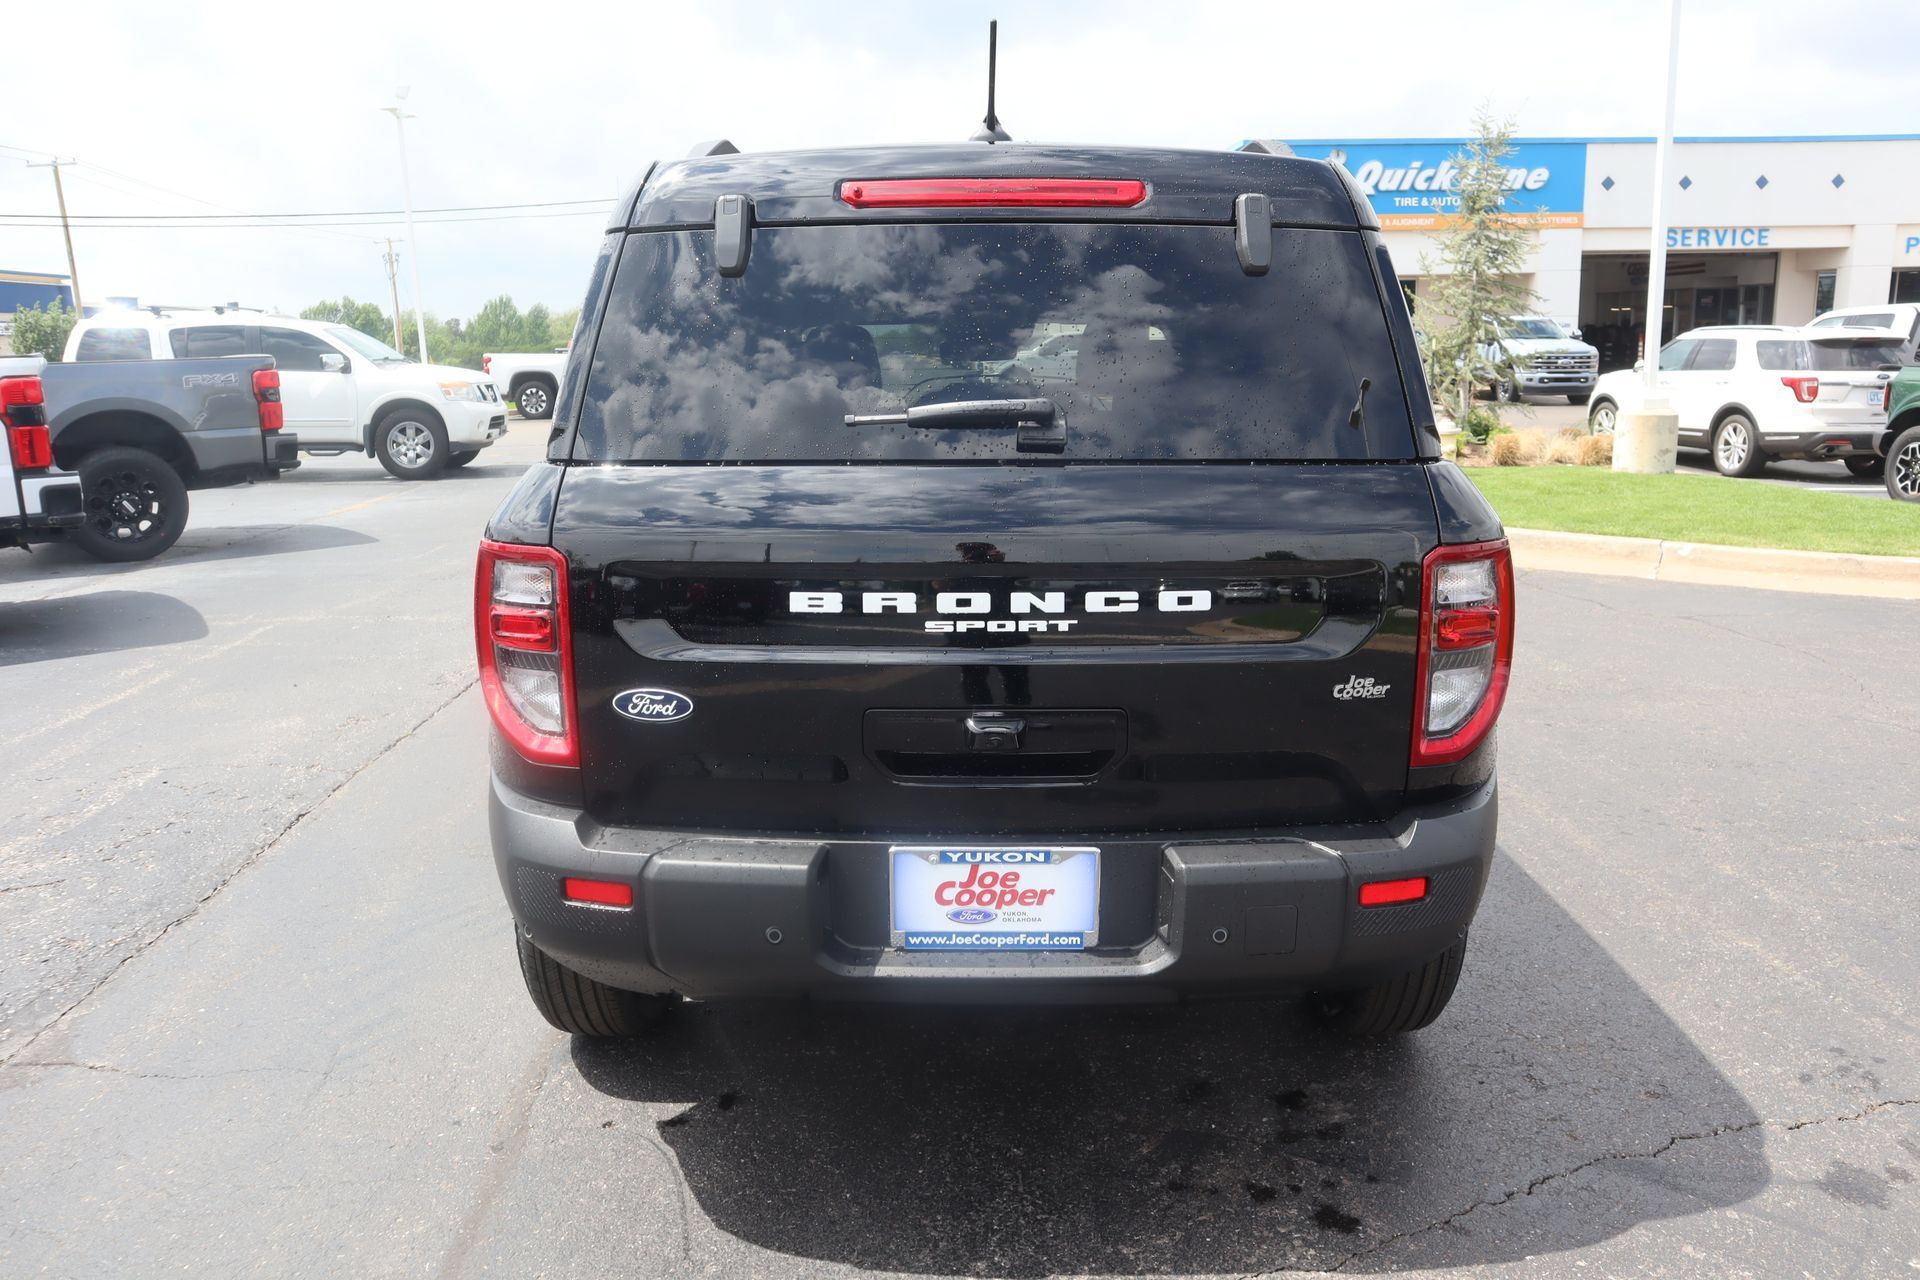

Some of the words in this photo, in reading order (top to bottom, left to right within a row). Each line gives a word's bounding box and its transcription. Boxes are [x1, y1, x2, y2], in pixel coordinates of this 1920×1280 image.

[1355, 160, 1454, 195] Quick
[1463, 163, 1550, 191] Lne
[1394, 197, 1419, 207] TIRE
[1421, 197, 1429, 207] &
[1431, 197, 1461, 207] AUTO
[1392, 217, 1436, 226] ALIGNMENT
[1666, 227, 1771, 248] SERVICE
[182, 372, 239, 389] FX4
[789, 590, 1212, 614] BRONCO
[924, 619, 1078, 633] SPORT
[1345, 675, 1375, 689] Joe
[1333, 684, 1391, 698] Cooper
[627, 693, 677, 716] Ford
[946, 852, 1046, 863] YUKON
[959, 864, 1020, 889] Joe
[935, 881, 1055, 910] Cooper
[960, 910, 985, 921] Ford
[908, 933, 1081, 948] www.JoeCooperFord.com
